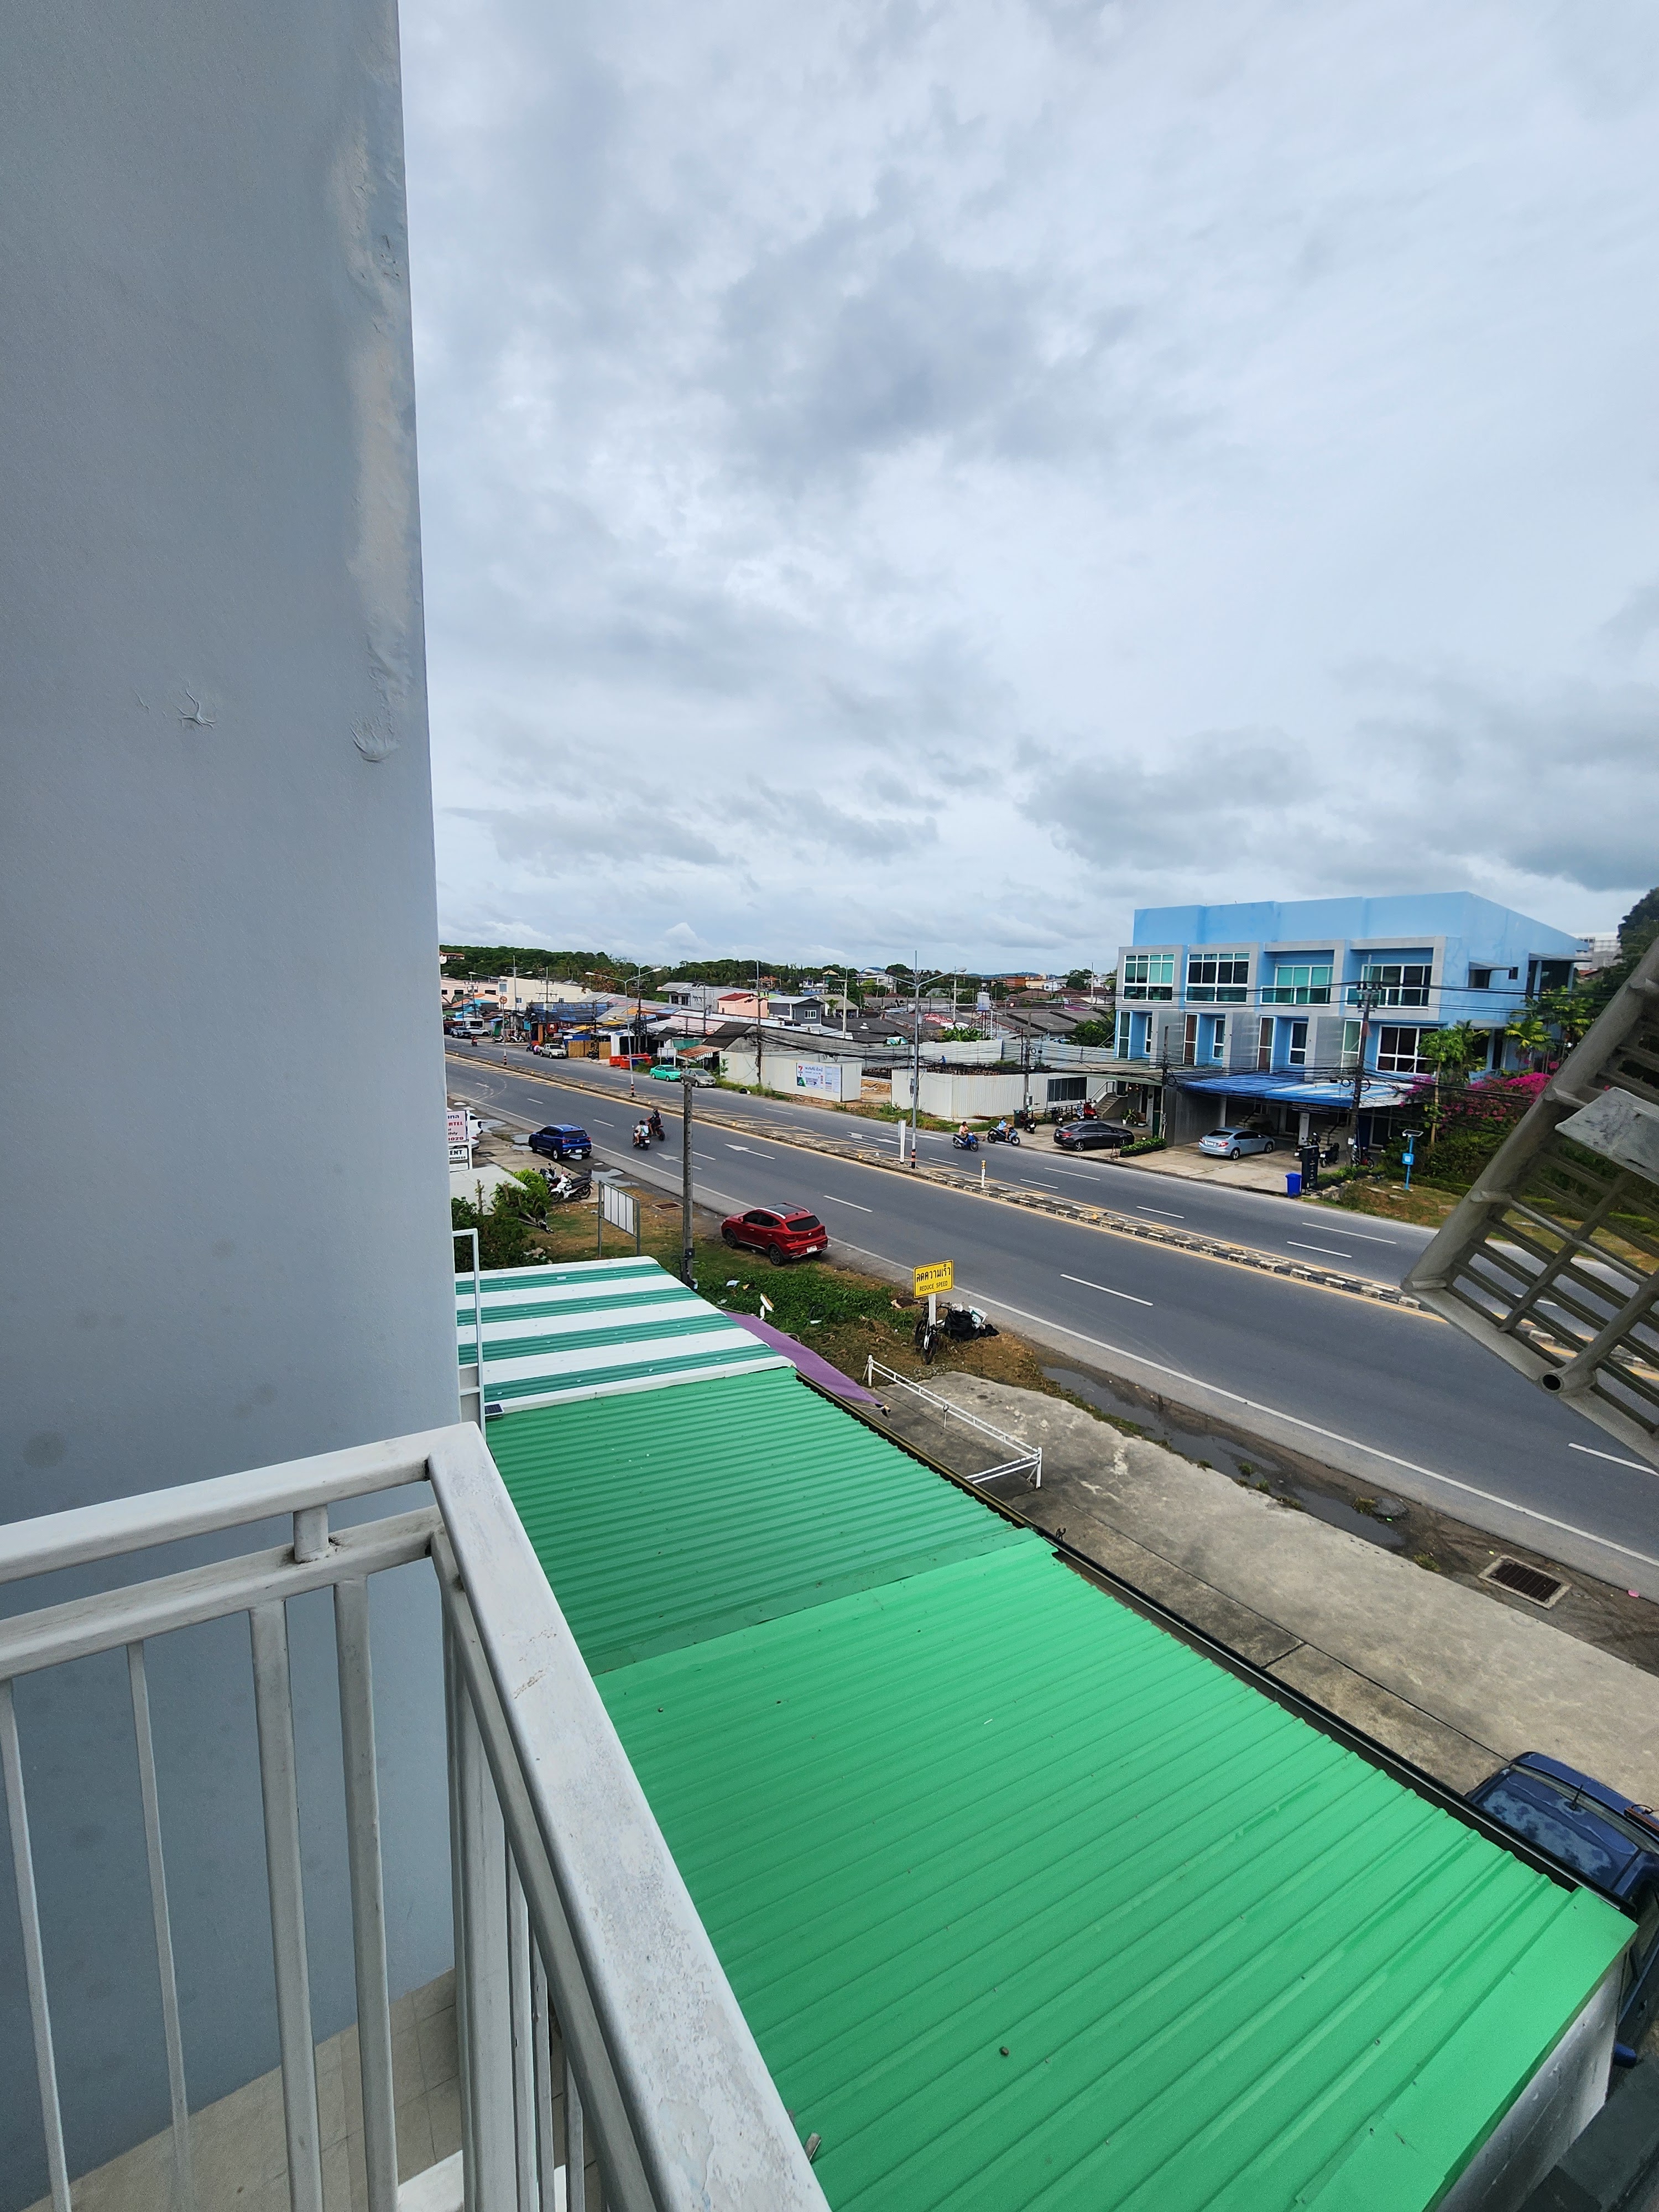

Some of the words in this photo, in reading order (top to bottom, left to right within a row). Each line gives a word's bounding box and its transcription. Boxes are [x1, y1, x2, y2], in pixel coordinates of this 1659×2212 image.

[916, 1264, 951, 1283] ลดความเร็ว
[919, 1283, 934, 1292] REDUCE
